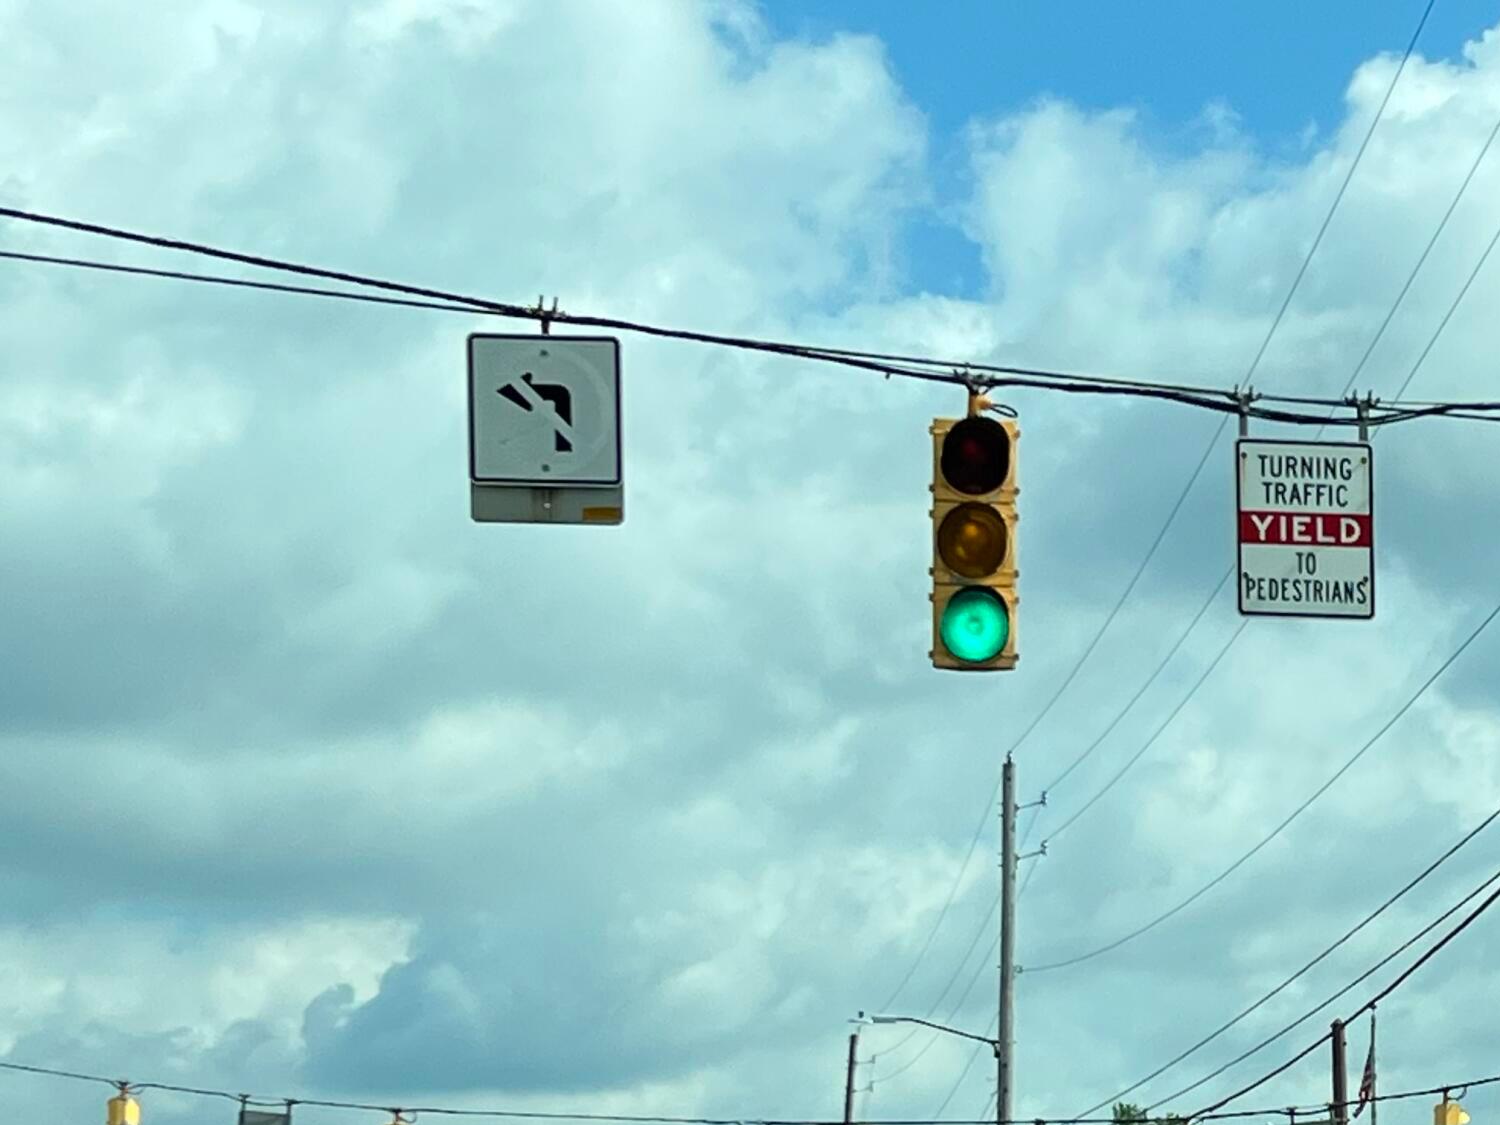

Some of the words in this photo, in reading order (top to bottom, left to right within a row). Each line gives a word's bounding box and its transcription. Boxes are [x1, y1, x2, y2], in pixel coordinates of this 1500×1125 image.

[1257, 454, 1352, 481] TURNING
[1261, 481, 1349, 507] TRAFFIC
[1250, 514, 1361, 543] YIELD
[1296, 552, 1317, 576] TO
[1245, 577, 1367, 605] PEDESTRIANS
